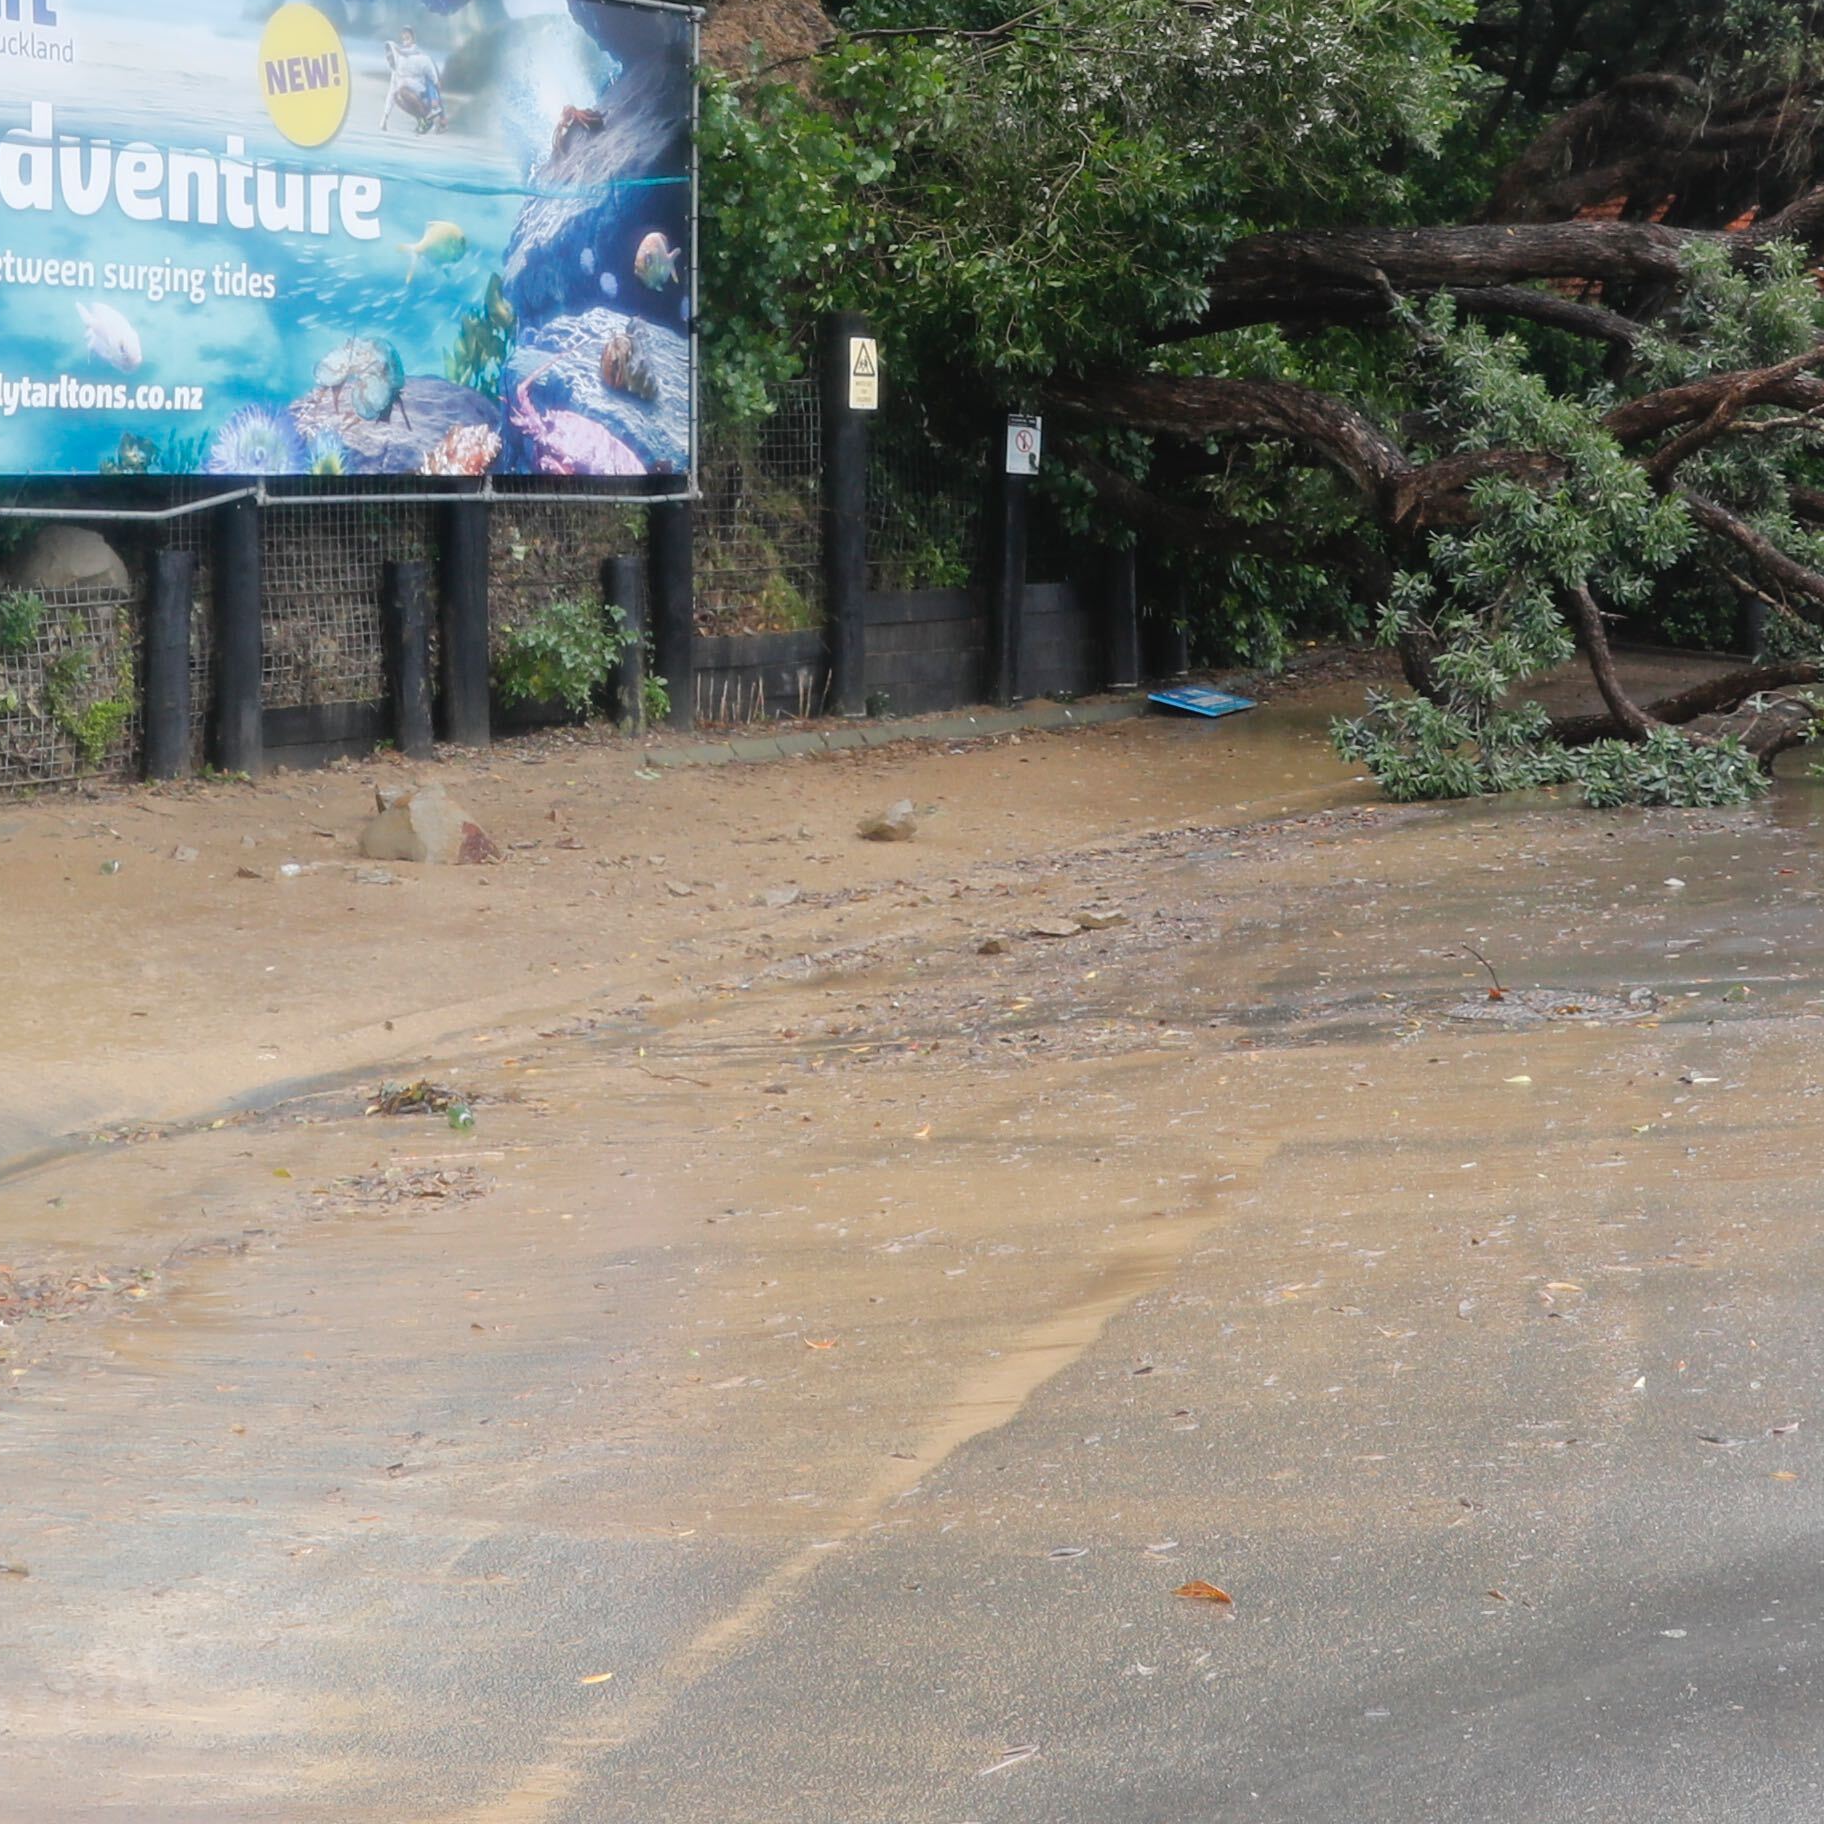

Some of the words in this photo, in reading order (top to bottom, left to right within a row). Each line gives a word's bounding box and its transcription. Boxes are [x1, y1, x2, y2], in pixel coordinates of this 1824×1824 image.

[264, 52, 342, 96] NEW!
[103, 257, 206, 304] surging
[211, 262, 277, 299] tides
